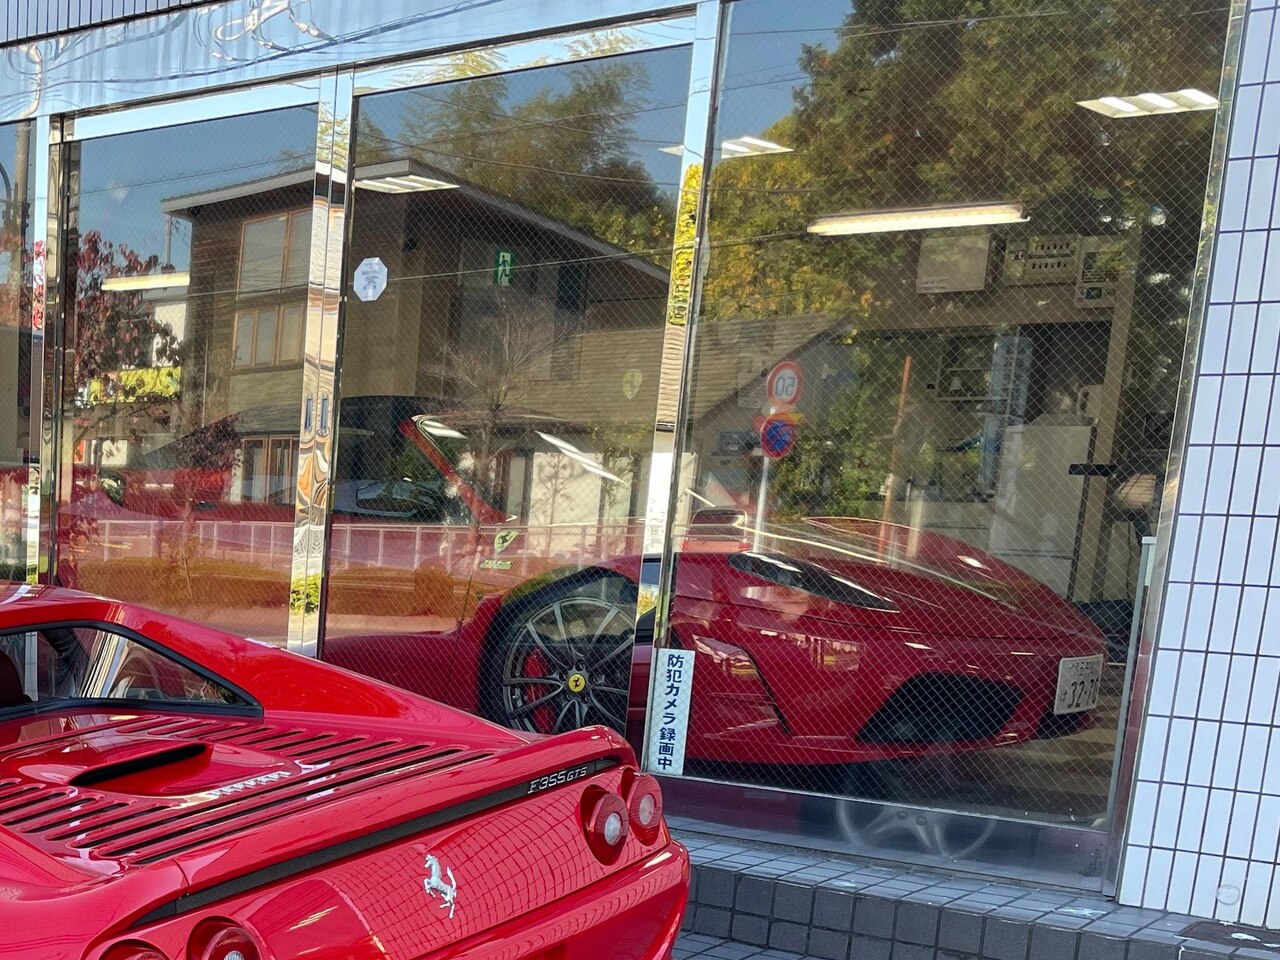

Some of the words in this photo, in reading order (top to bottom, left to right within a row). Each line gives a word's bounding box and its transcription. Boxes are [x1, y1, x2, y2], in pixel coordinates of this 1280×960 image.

[657, 653, 685, 770] 防犯カメラ録画中
[527, 769, 567, 794] F355
[566, 766, 588, 782] GTS
